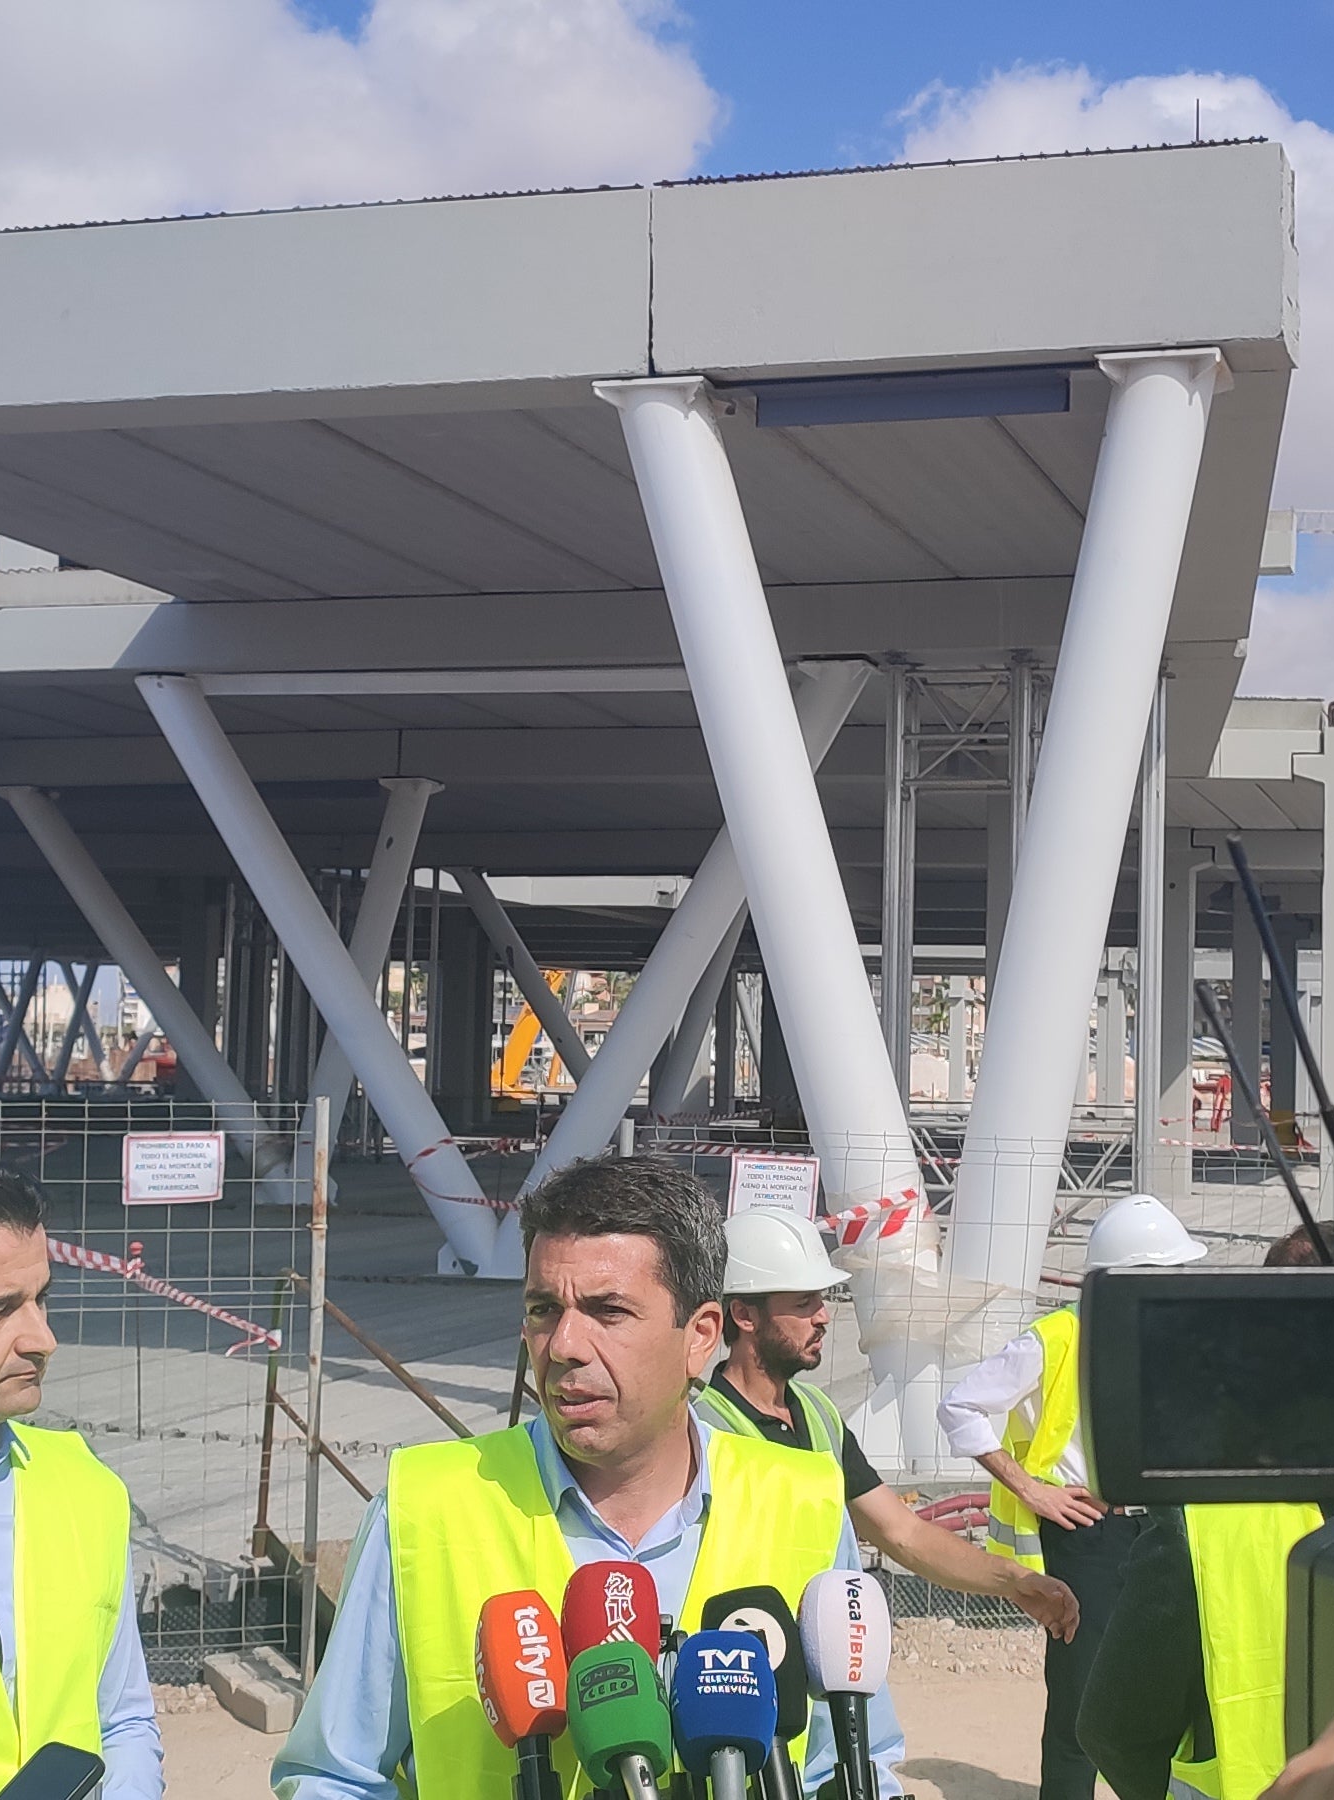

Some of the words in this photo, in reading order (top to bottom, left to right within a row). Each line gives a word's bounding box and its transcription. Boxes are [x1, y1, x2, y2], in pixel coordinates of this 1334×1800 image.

[513, 1605, 551, 1678] telfy
[697, 1649, 756, 1670] TVT
[584, 1666, 625, 1684] ONDA
[698, 1674, 758, 1687] TELEVISIÓN
[588, 1680, 628, 1698] CERO
[697, 1684, 761, 1697] TORREVIEJA
